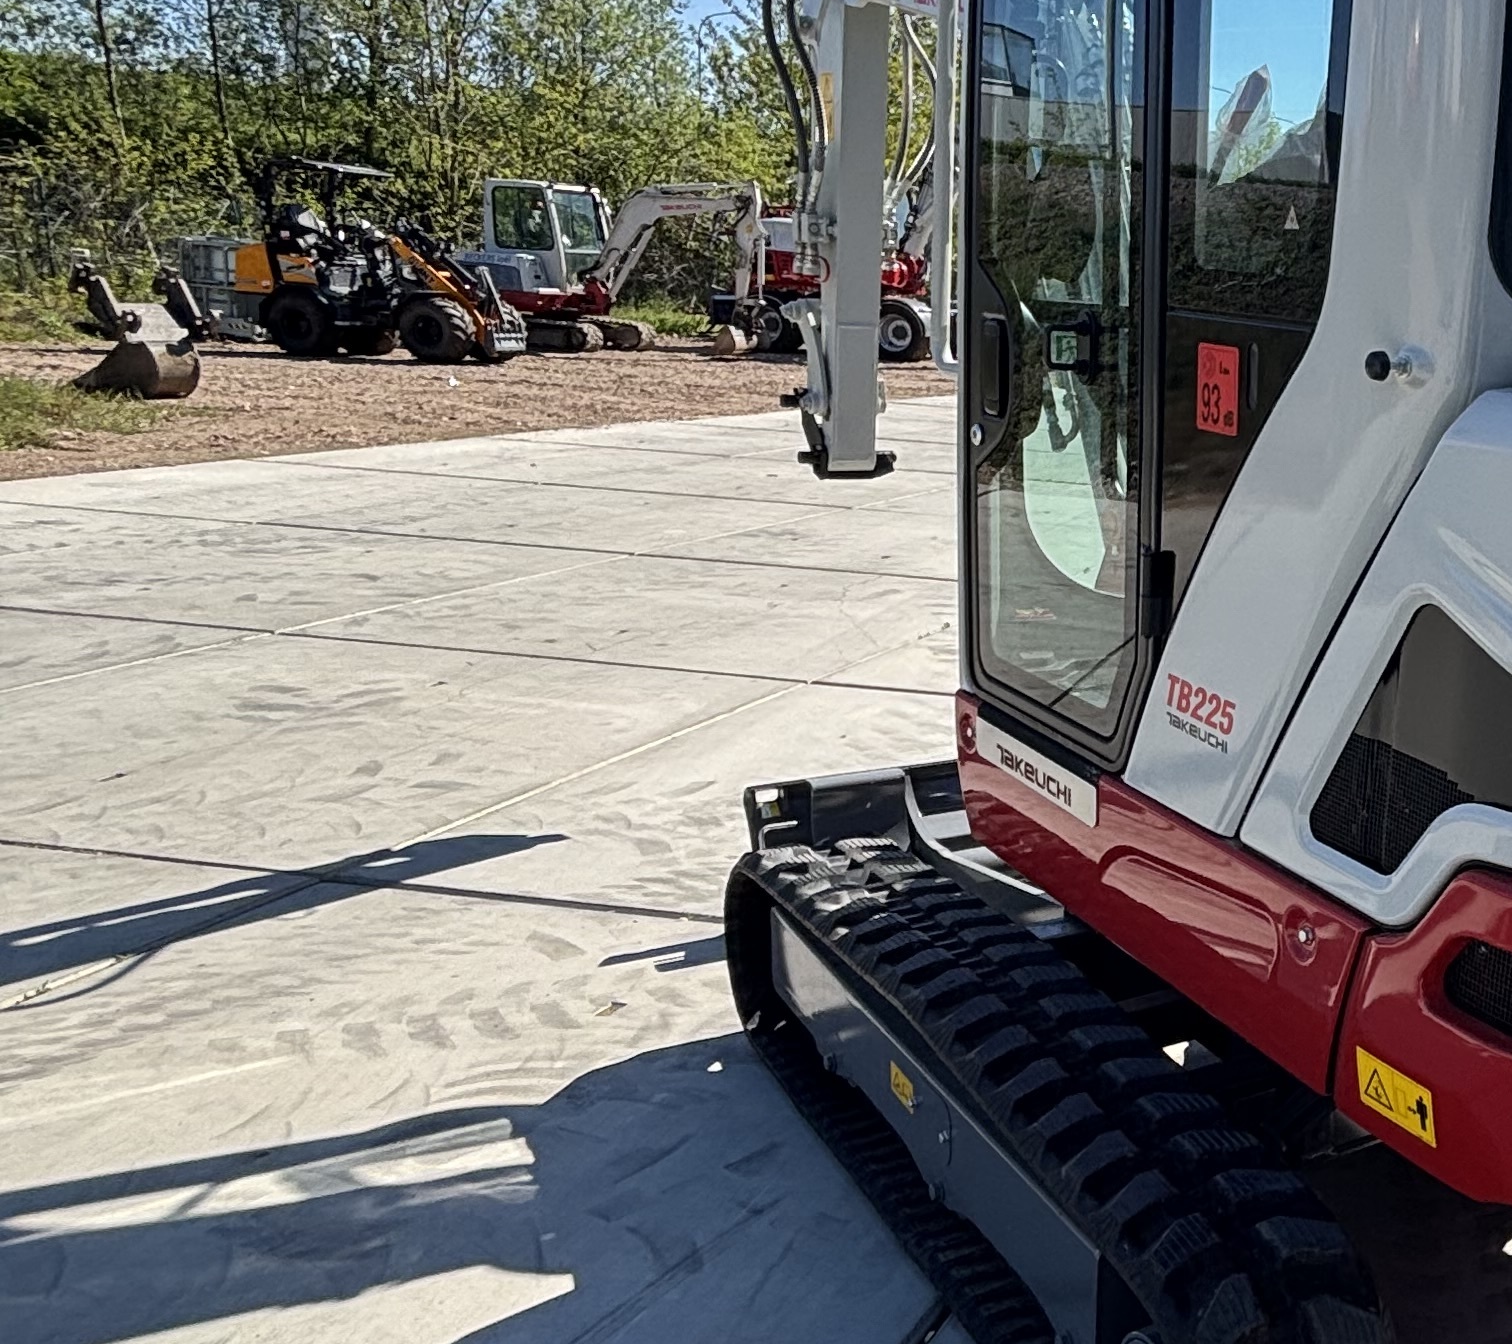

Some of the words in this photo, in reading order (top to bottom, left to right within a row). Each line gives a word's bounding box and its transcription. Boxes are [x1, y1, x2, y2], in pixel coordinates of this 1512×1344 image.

[1201, 381, 1221, 425] 93
[1166, 671, 1237, 736] TB225
[1166, 711, 1229, 755] TAKEUCHI
[996, 742, 1072, 808] TAKEUCHI
